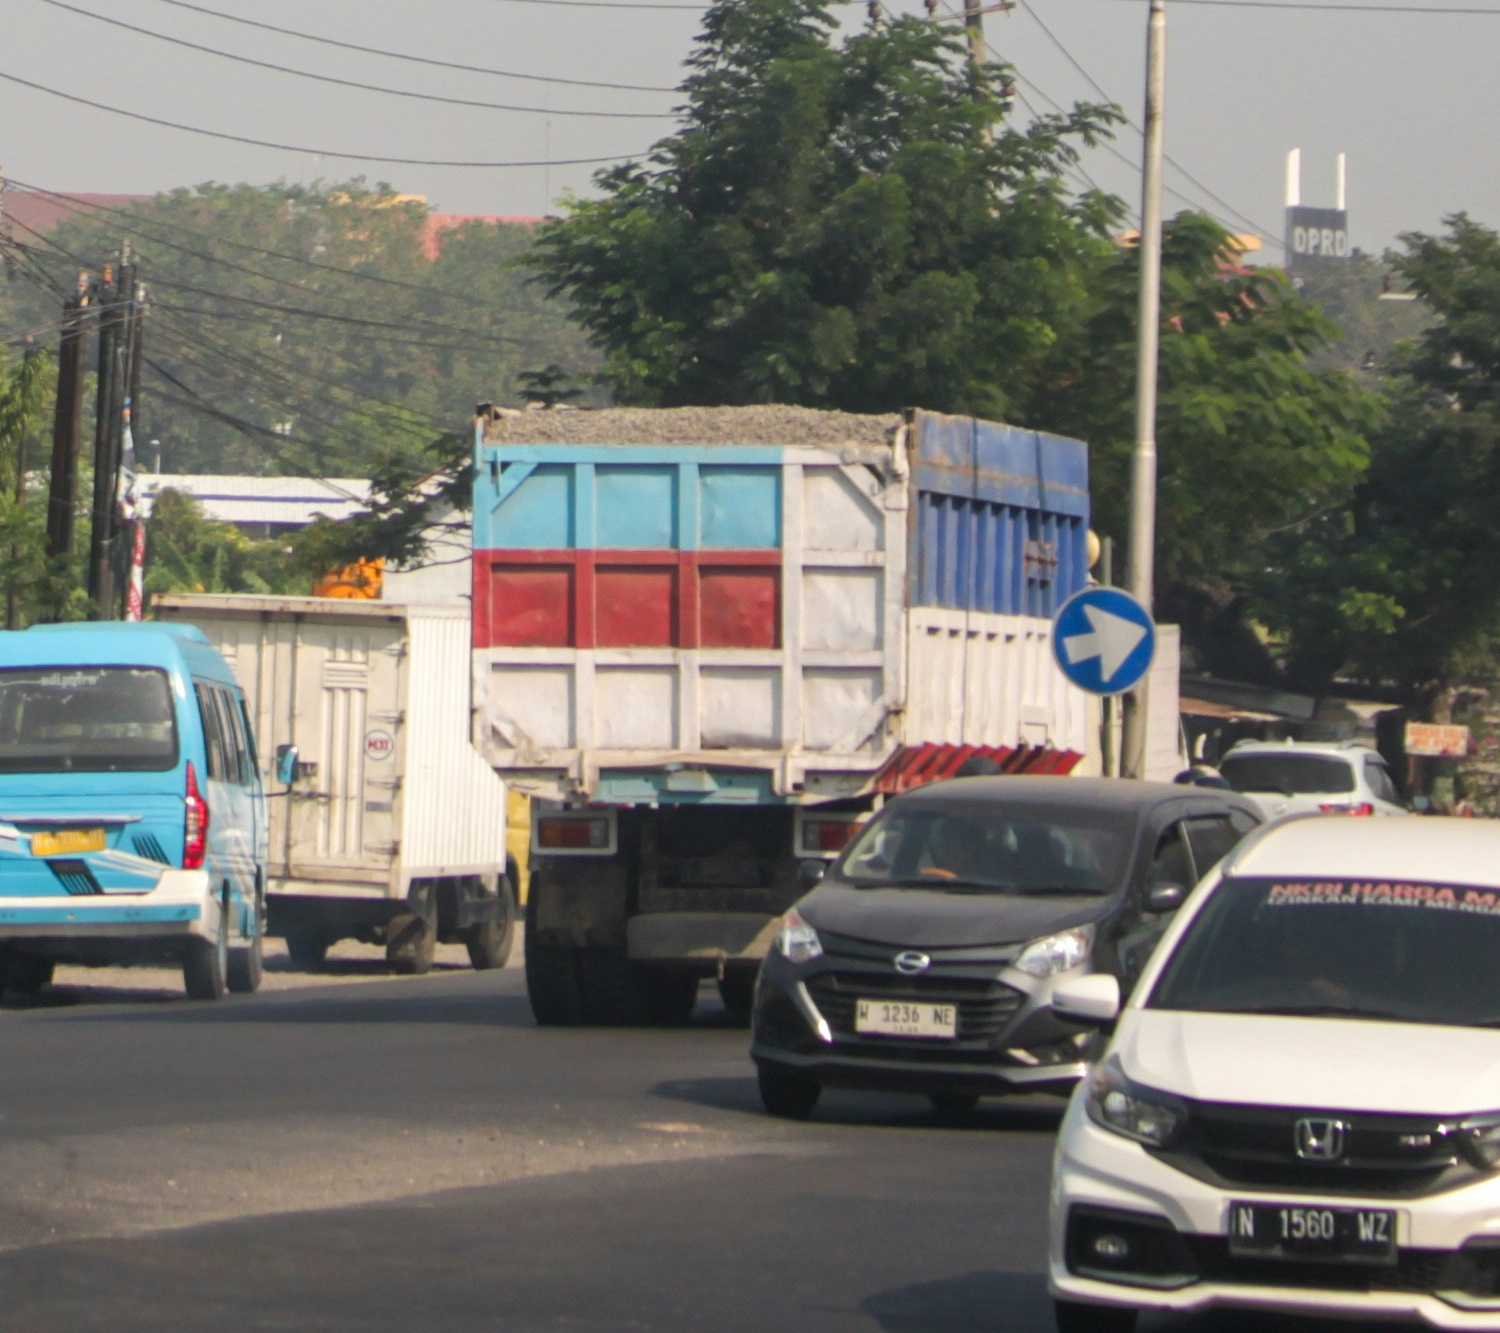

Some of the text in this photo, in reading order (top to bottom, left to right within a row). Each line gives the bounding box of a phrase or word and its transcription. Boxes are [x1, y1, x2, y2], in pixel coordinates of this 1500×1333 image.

[1293, 226, 1349, 257] DPRD
[1351, 882, 1457, 903] HARGA
[881, 1004, 920, 1023] 1236
[933, 1007, 953, 1026] NE
[1238, 1207, 1389, 1243] N 1560 WZ
